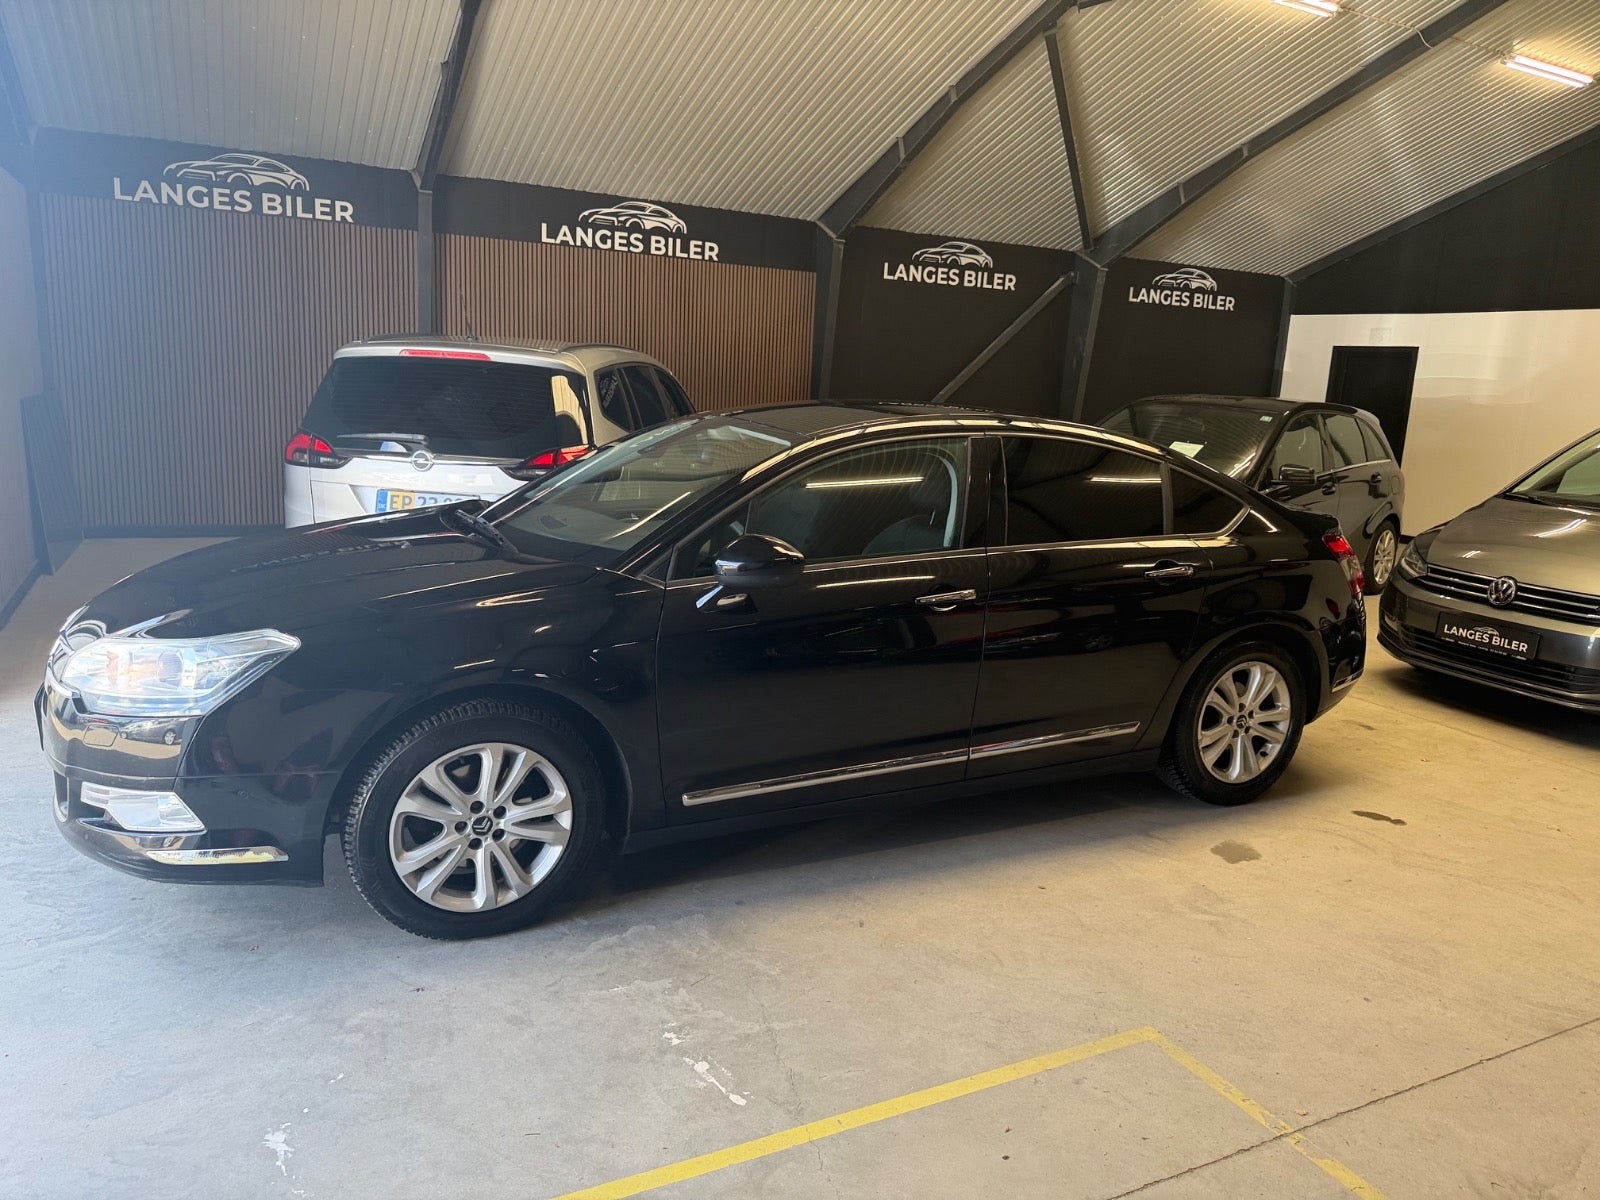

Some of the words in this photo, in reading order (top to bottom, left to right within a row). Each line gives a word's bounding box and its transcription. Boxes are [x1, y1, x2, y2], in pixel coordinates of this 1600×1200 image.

[113, 177, 252, 212] LANGES
[262, 193, 354, 223] BILER
[541, 223, 644, 253] LANGES
[650, 236, 719, 261] BILER
[883, 262, 960, 285] LANGES
[964, 270, 1017, 291] BILER
[1128, 287, 1190, 307] LANGES
[1193, 293, 1235, 311] BILER
[390, 494, 412, 511] EP
[1444, 624, 1490, 643] LANGES
[1492, 636, 1528, 653] BILER
